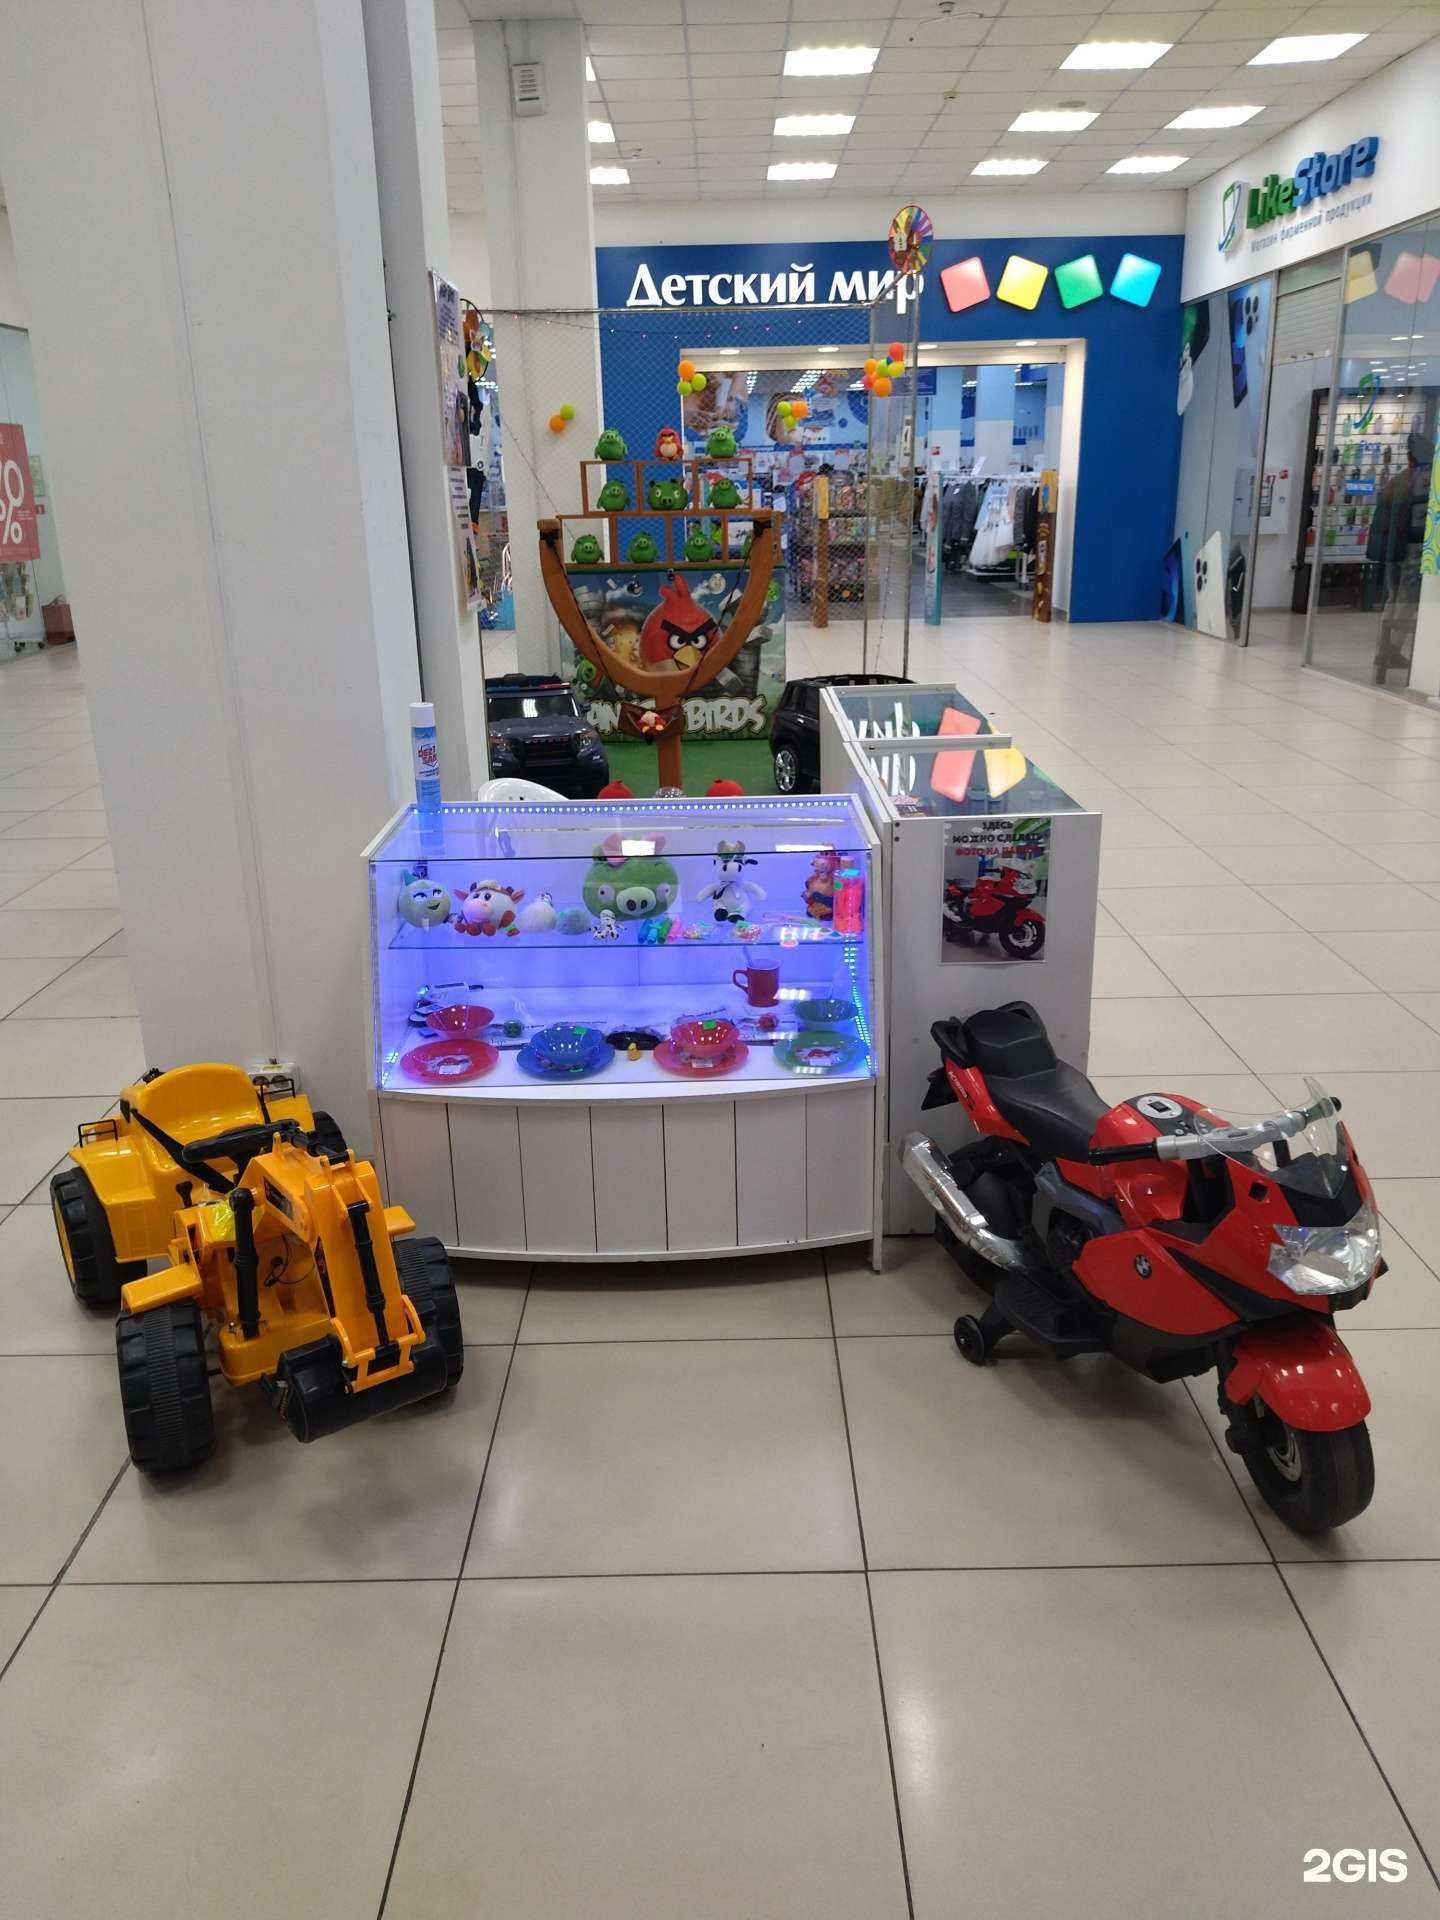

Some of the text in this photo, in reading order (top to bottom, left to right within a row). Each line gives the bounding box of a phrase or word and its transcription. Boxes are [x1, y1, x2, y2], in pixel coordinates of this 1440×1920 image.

[1246, 136, 1379, 229] LikeStore
[626, 263, 924, 315] Детский мир
[682, 695, 767, 734] BIRDS
[953, 834, 995, 844] МОЖНО
